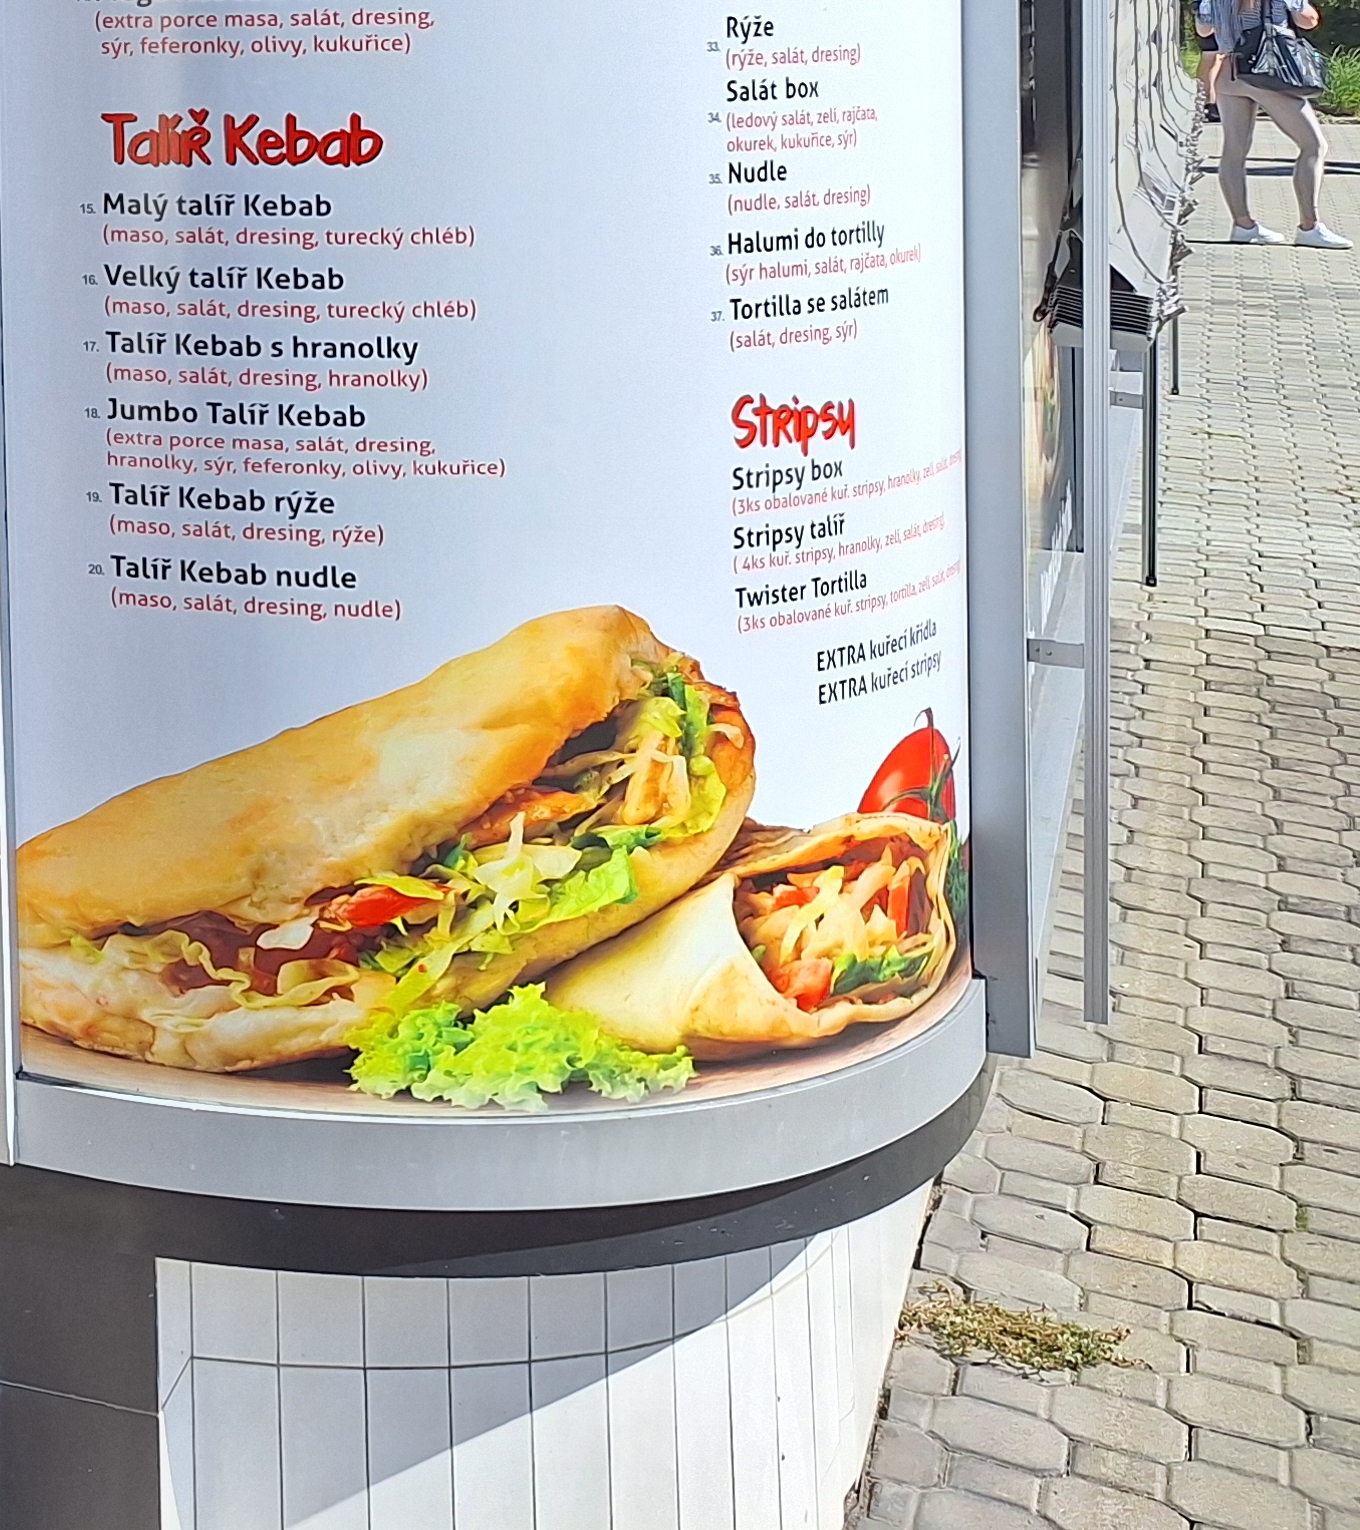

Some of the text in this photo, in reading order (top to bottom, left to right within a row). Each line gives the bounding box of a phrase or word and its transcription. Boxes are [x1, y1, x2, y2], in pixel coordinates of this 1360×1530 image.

[726, 14, 774, 45] Rýže
[726, 75, 820, 103] Salát box
[225, 113, 383, 167] Kebab
[728, 158, 788, 184] Nudle
[103, 192, 332, 222] Malý talíř Kebab
[324, 226, 405, 251] turecký
[727, 219, 885, 255] Halumi do tortilly
[728, 285, 889, 321] Tortilla se salátem
[104, 330, 419, 367] Talíř Kebab s hranolky
[106, 397, 366, 428] Jumbo Talíř Kebab
[731, 457, 843, 493] Stripsy box
[109, 554, 357, 589] Talíř Kebab nudle
[734, 568, 867, 609] Twister Tortilla
[816, 641, 866, 672] EXTRA
[869, 628, 908, 660] kuřecí
[818, 674, 868, 706] EXTRA
[870, 660, 909, 693] kuřecí
